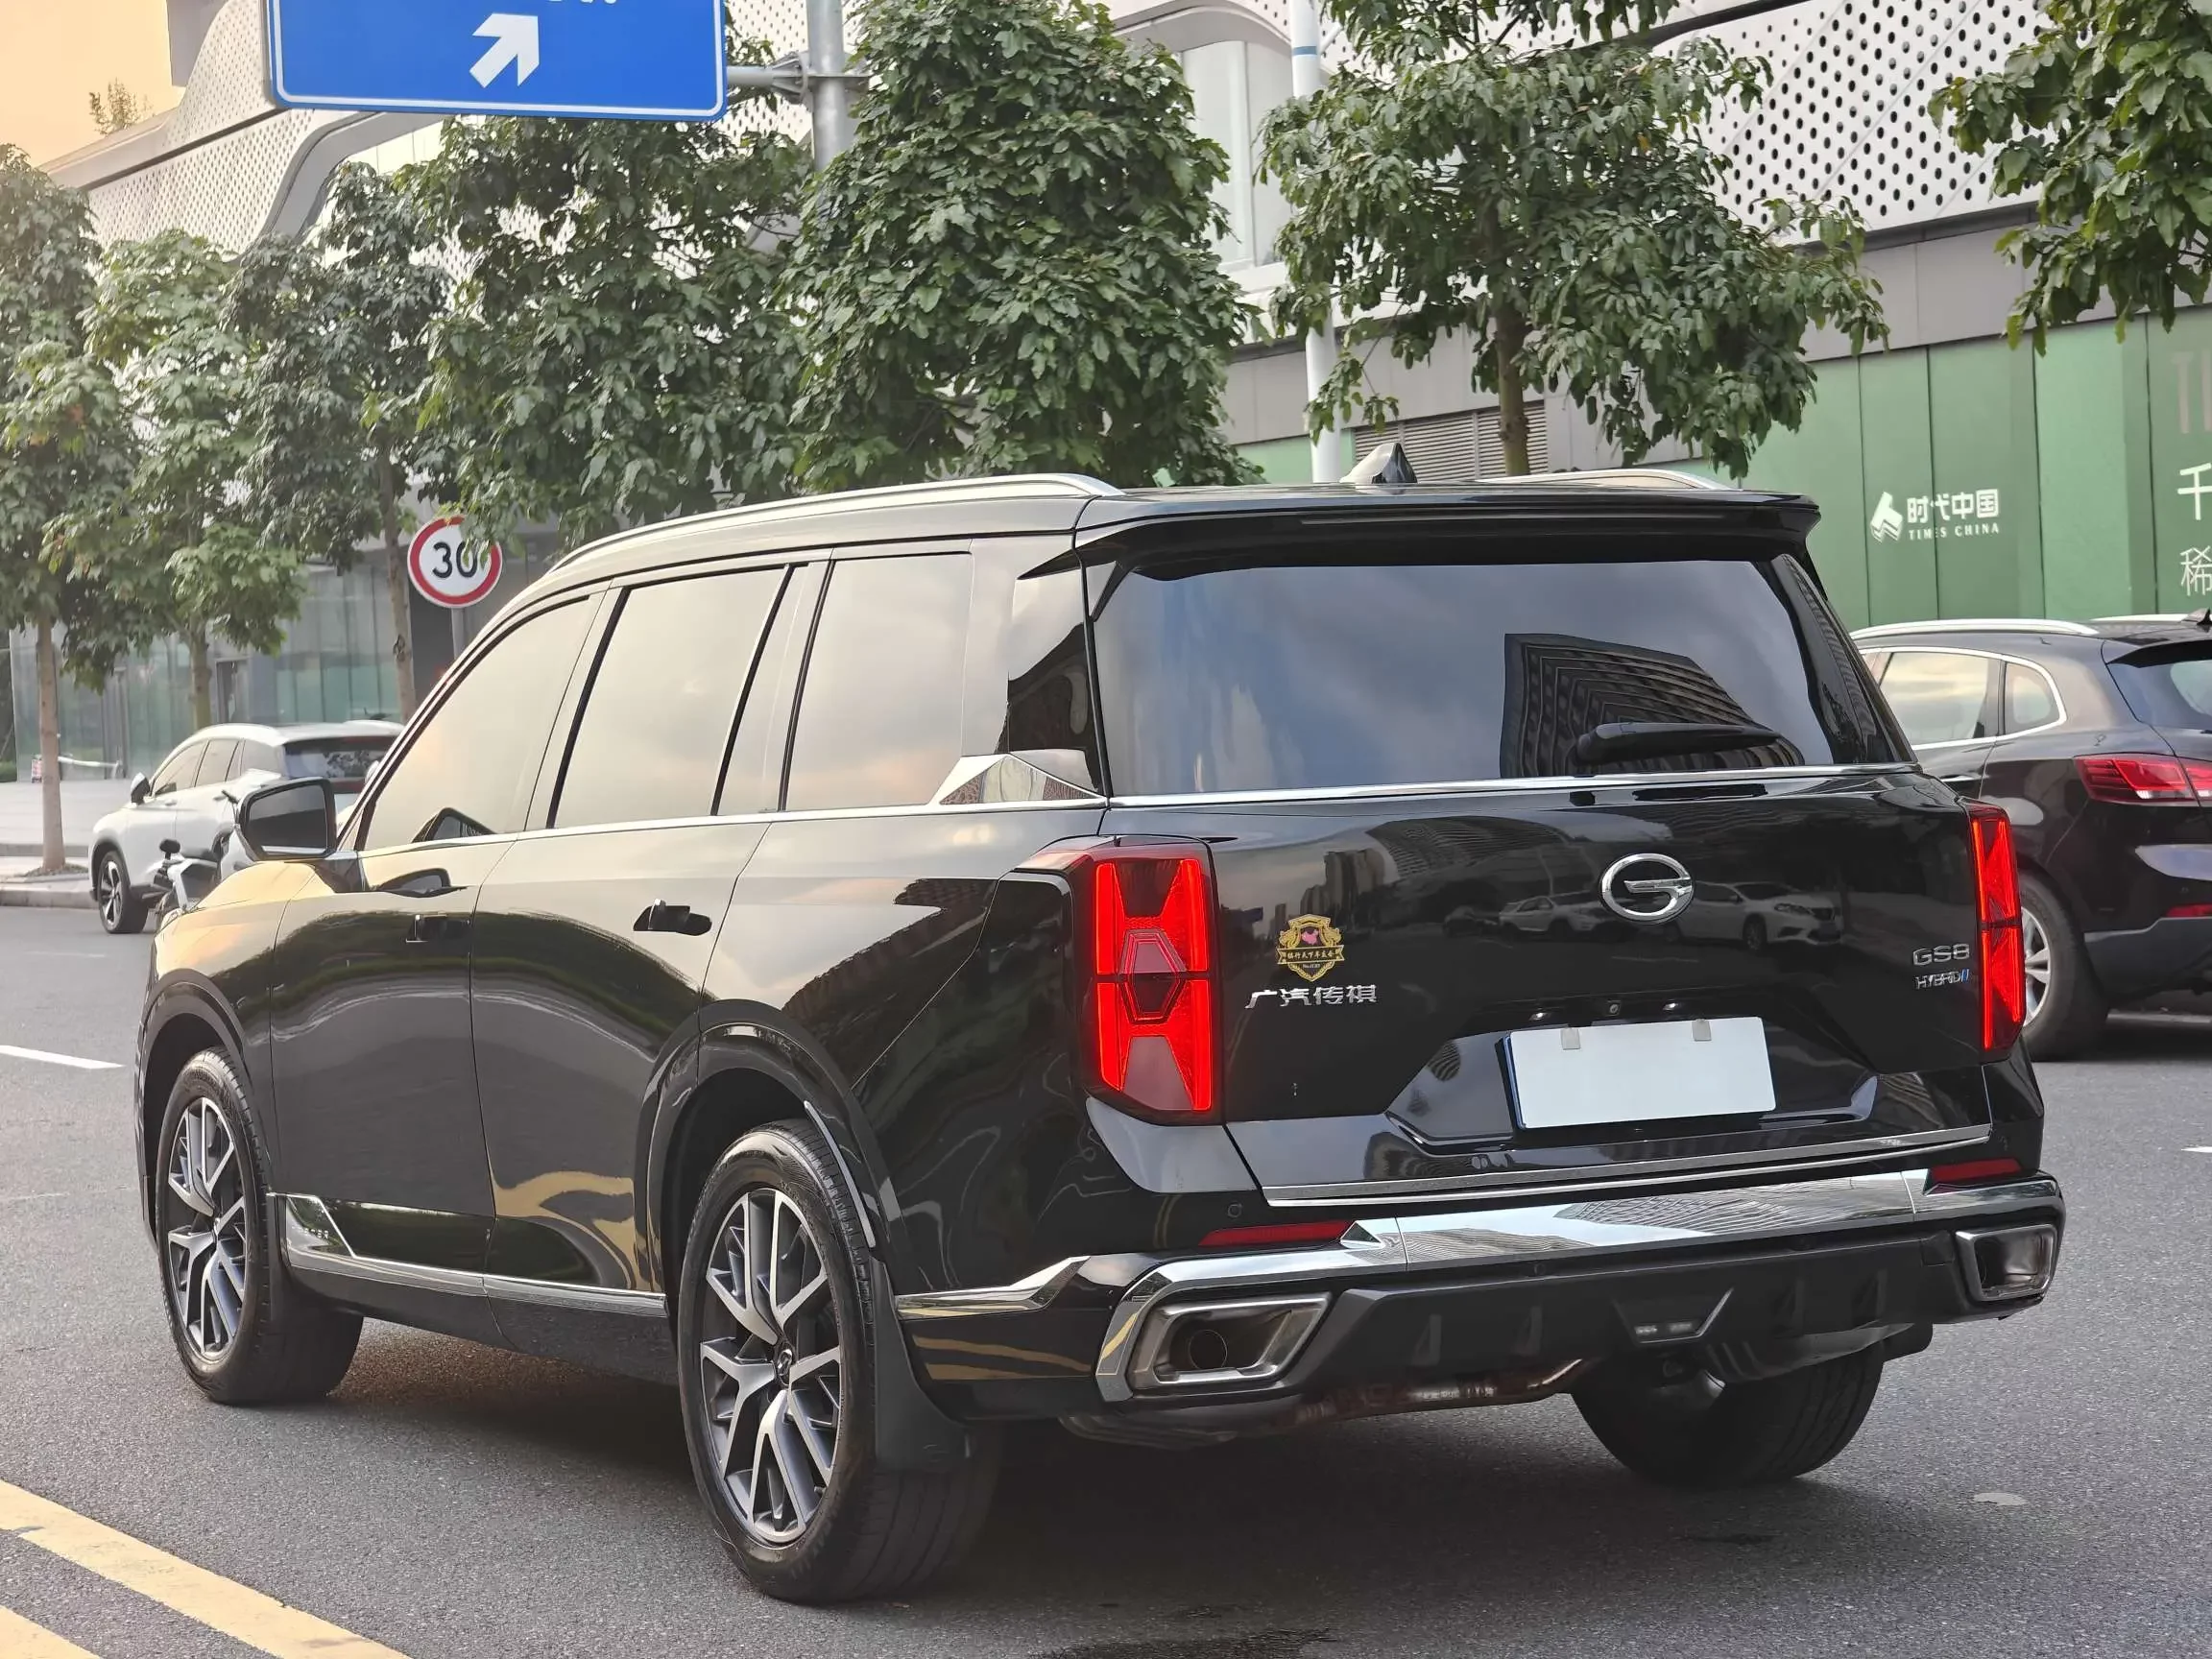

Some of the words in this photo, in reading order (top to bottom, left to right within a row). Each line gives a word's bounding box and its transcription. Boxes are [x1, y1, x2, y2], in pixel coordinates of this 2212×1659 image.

[1907, 489, 1999, 523] 时代中国
[1909, 527, 1947, 541] TIMES
[1954, 521, 2000, 538] CHINA
[432, 541, 478, 579] 30
[1912, 943, 1970, 966] GS8
[1244, 984, 1377, 1009] 广汽传祺
